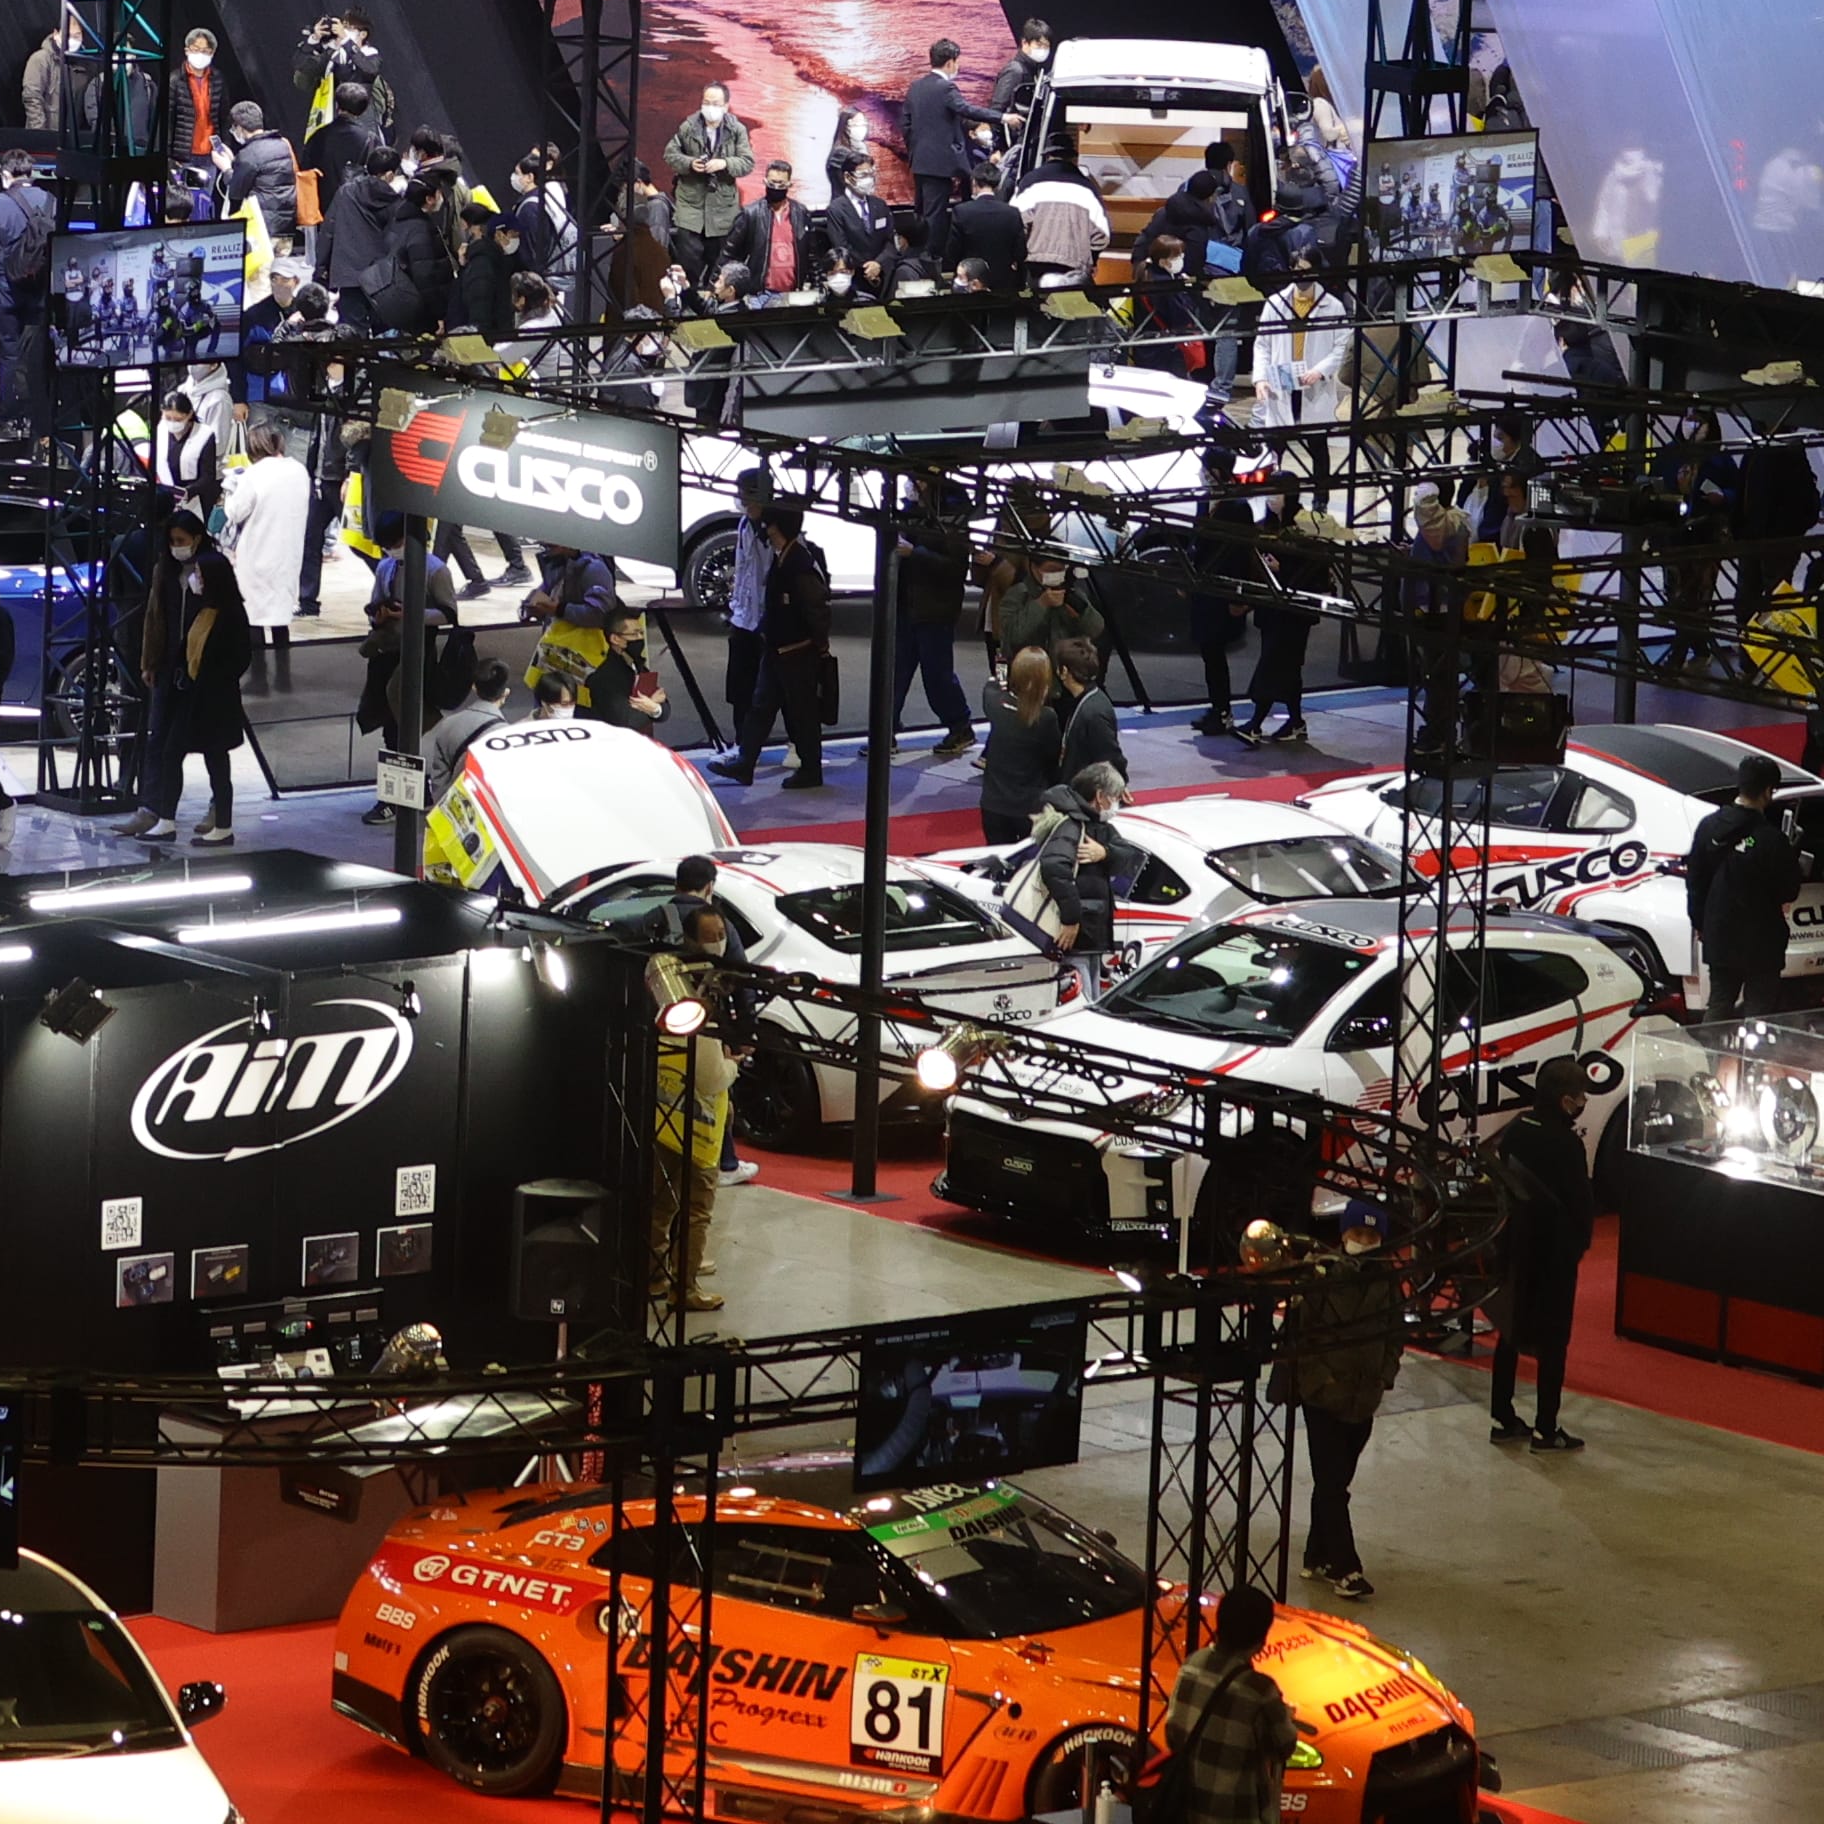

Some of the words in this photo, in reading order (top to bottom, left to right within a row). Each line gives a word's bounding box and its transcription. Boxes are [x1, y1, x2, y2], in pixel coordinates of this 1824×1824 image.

[457, 443, 644, 525] CUSCO
[485, 726, 592, 751] CUSCO
[1002, 1157, 1033, 1172] CUSCO
[527, 1528, 587, 1552] GT3
[451, 1564, 573, 1606] GTNET
[375, 1602, 417, 1630] BBS
[864, 1679, 933, 1750] 81
[1323, 1677, 1418, 1725] DAISHIN
